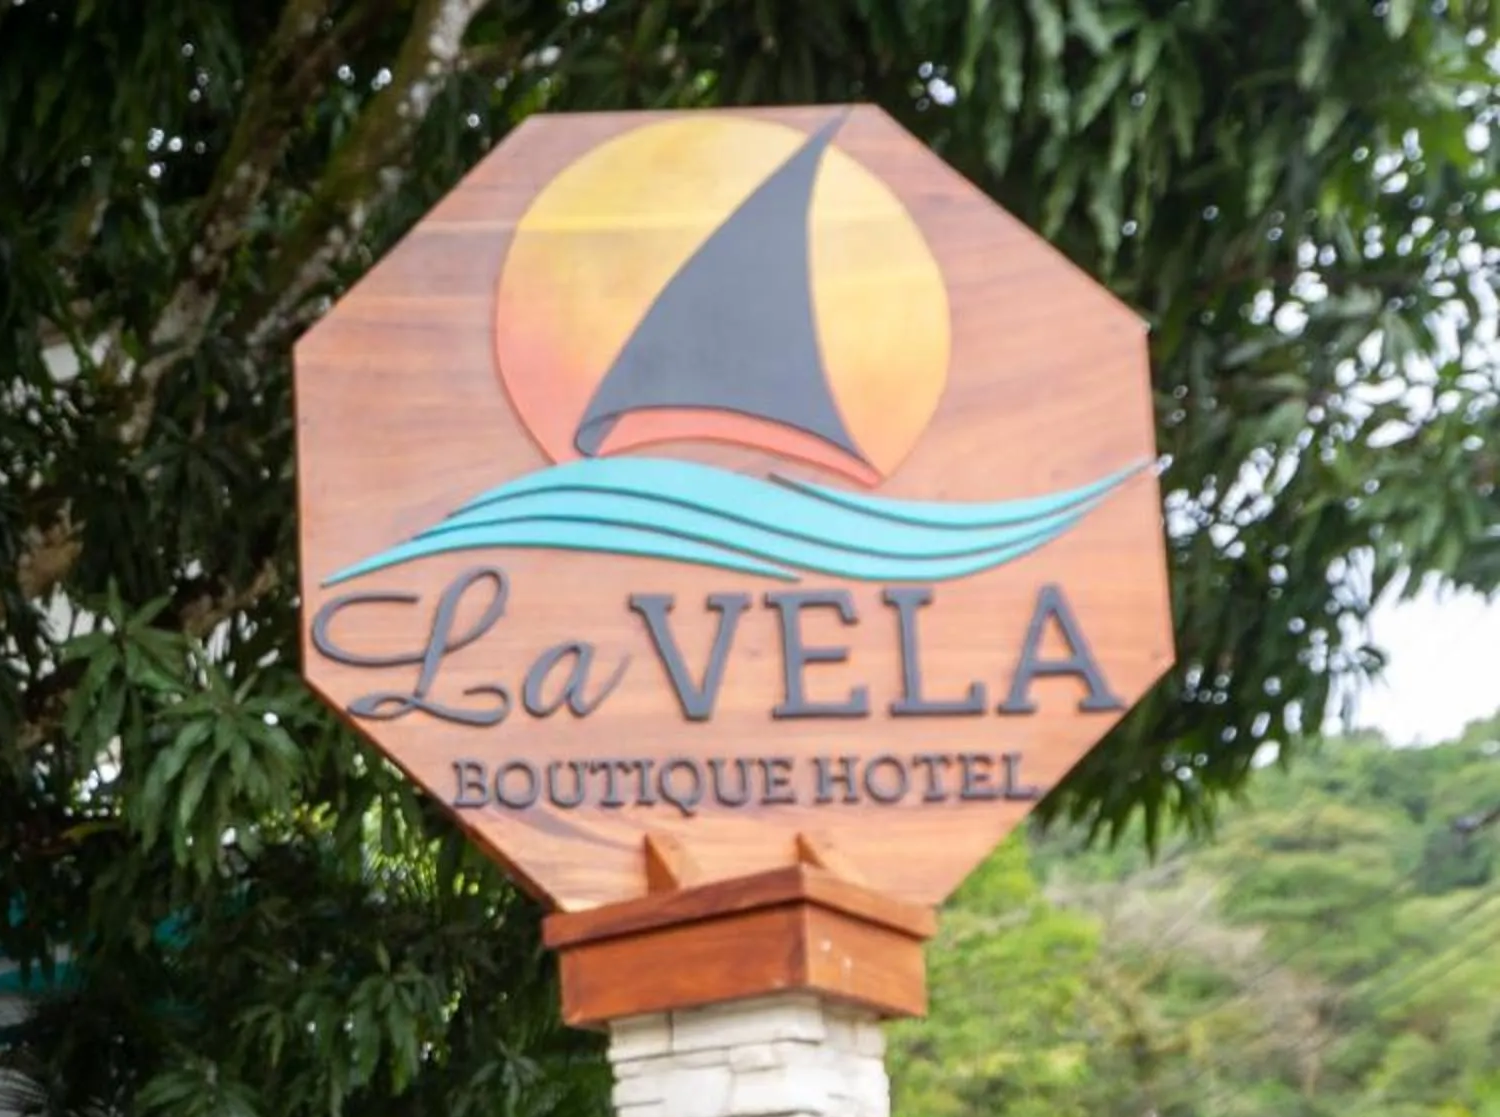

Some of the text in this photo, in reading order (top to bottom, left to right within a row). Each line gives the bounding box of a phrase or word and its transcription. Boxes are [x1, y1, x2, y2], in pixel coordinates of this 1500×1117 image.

[311, 566, 1126, 726] La VELA
[451, 752, 1040, 817] BOUTIQUE HOTEL
